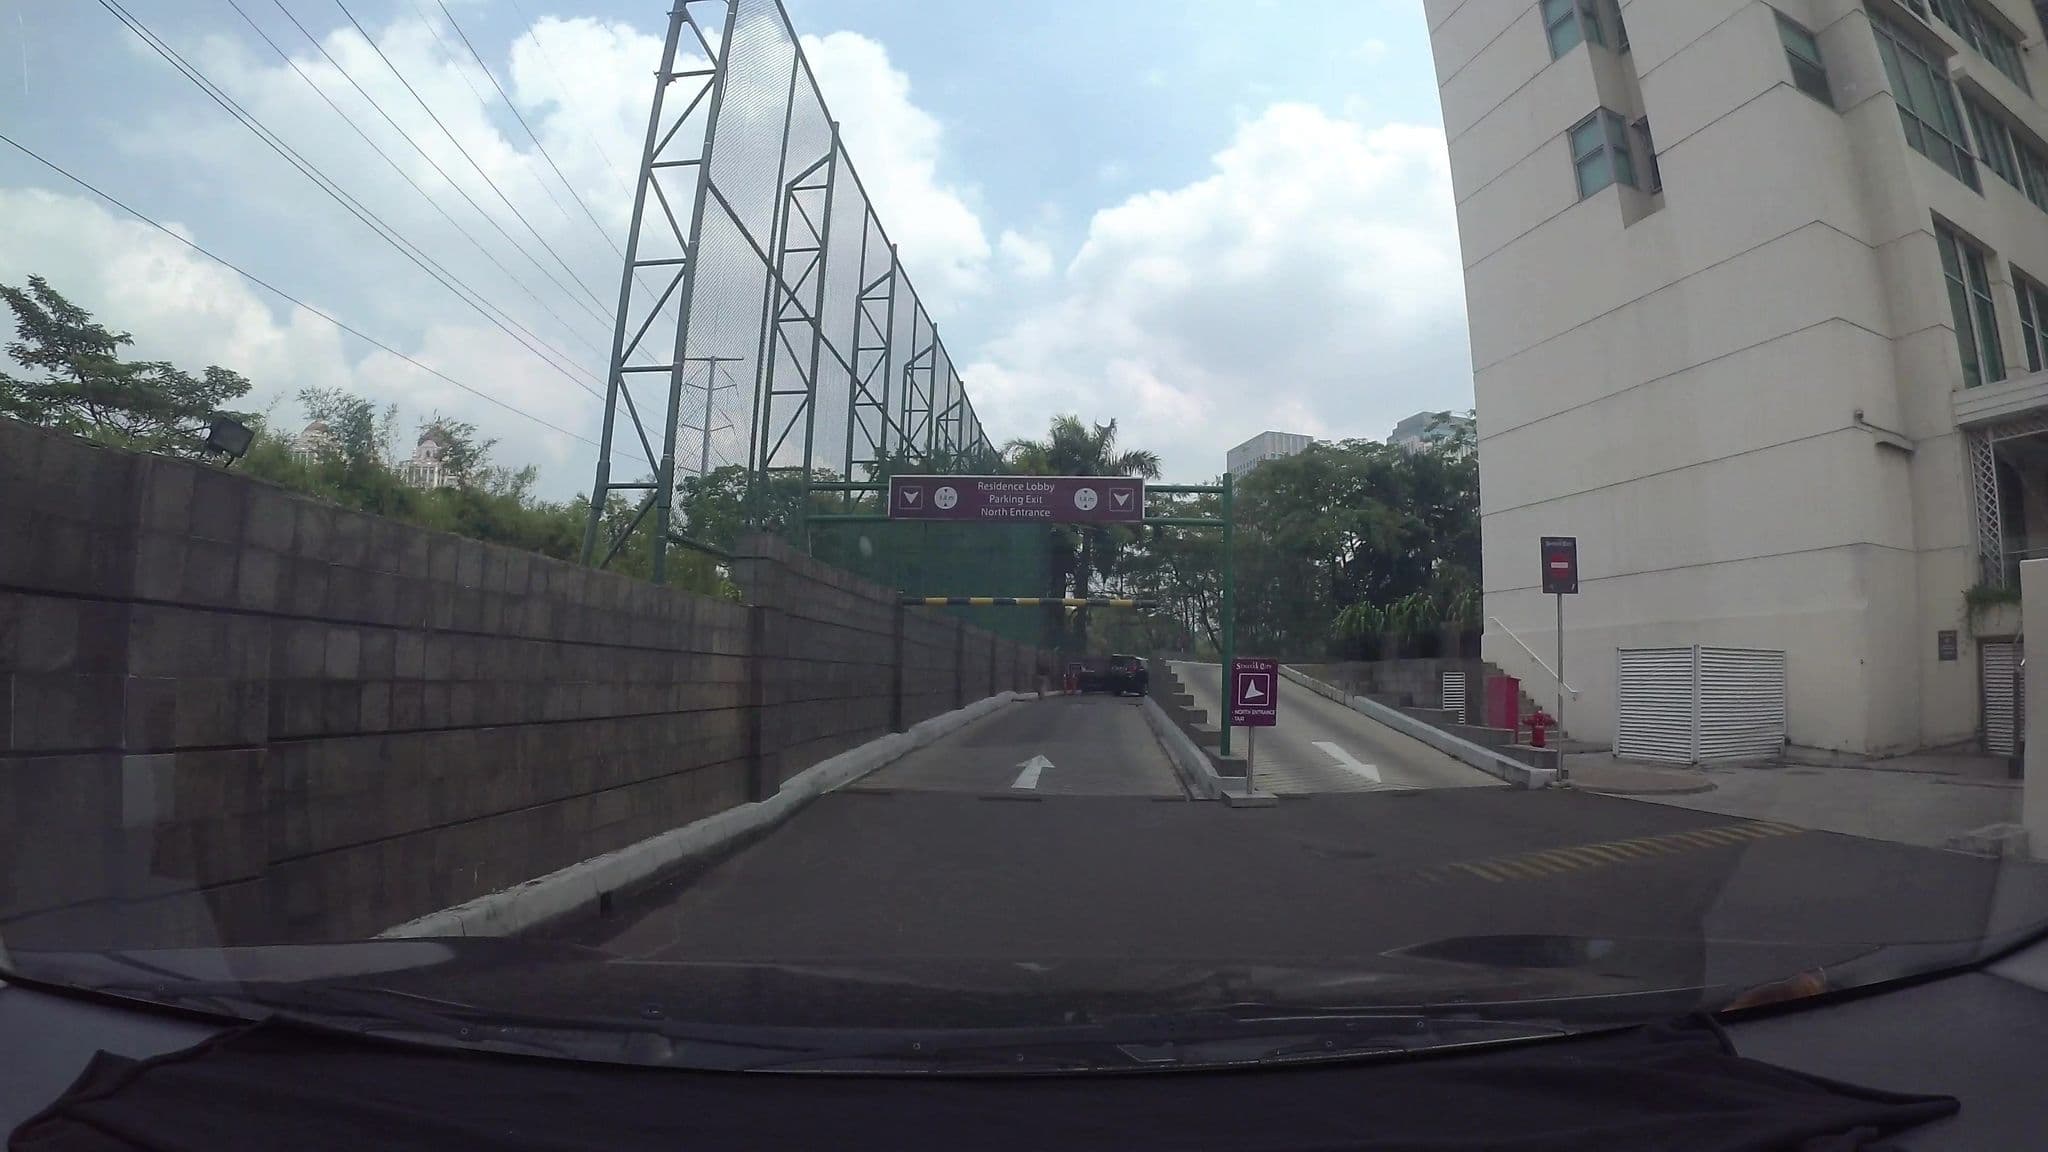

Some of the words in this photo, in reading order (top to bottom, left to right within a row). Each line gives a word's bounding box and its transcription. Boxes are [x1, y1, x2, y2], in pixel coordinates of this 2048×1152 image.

[977, 481, 1024, 491] Residence
[1026, 481, 1055, 493] Lobby
[989, 494, 1024, 506] Parking
[1026, 494, 1042, 504] Exit
[981, 507, 1008, 516] North
[1010, 507, 1051, 517] Entrance
